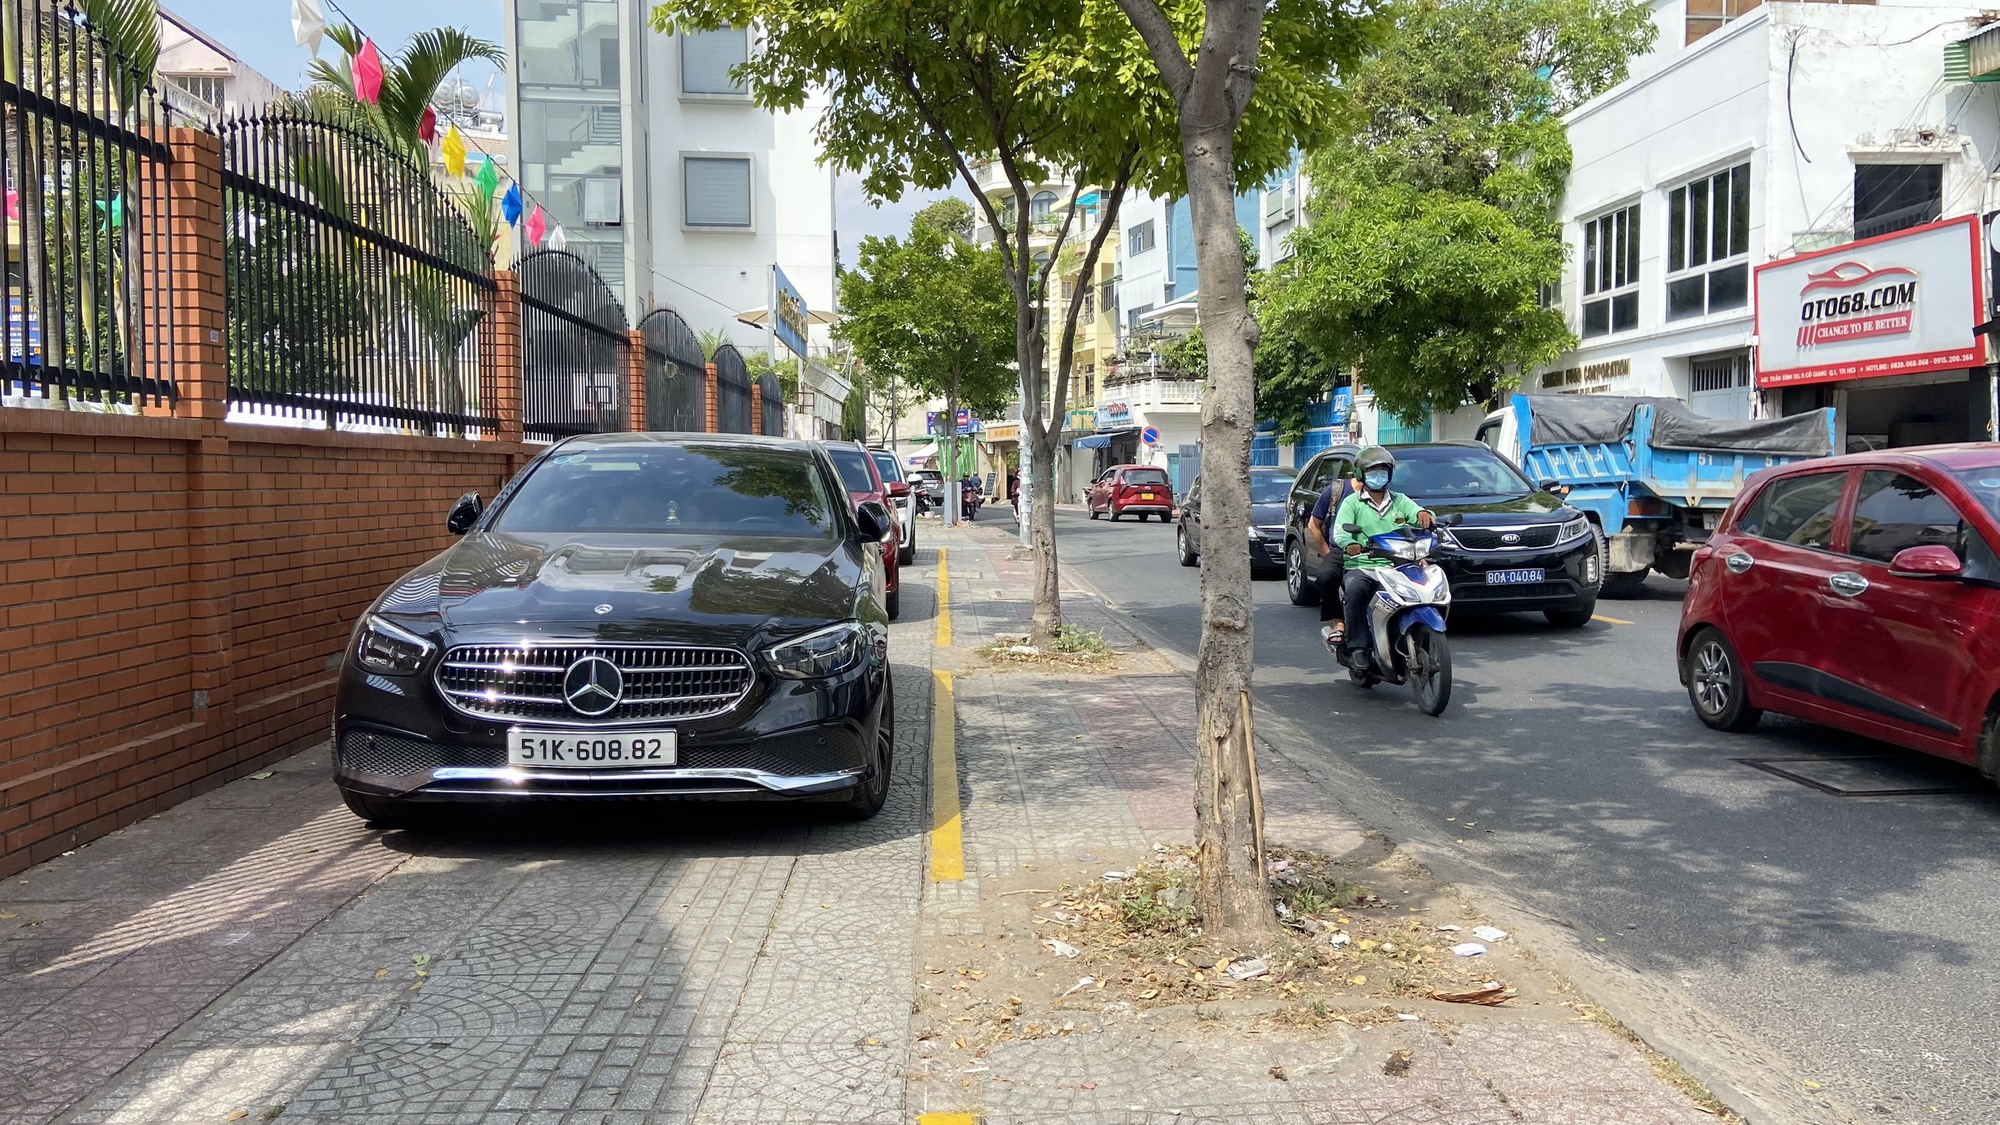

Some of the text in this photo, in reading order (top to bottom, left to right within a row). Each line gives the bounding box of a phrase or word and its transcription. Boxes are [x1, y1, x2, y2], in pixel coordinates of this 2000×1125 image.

[1802, 281, 1917, 321] OTO68.COM
[1817, 316, 1908, 338] CHANGE TO BE BETTER
[1584, 358, 1631, 382] CORPORATION
[1698, 453, 1713, 466] 51
[1503, 535, 1519, 543] KIA
[1488, 570, 1542, 584] 80A-040.84
[521, 738, 662, 760] 51K-608.82
